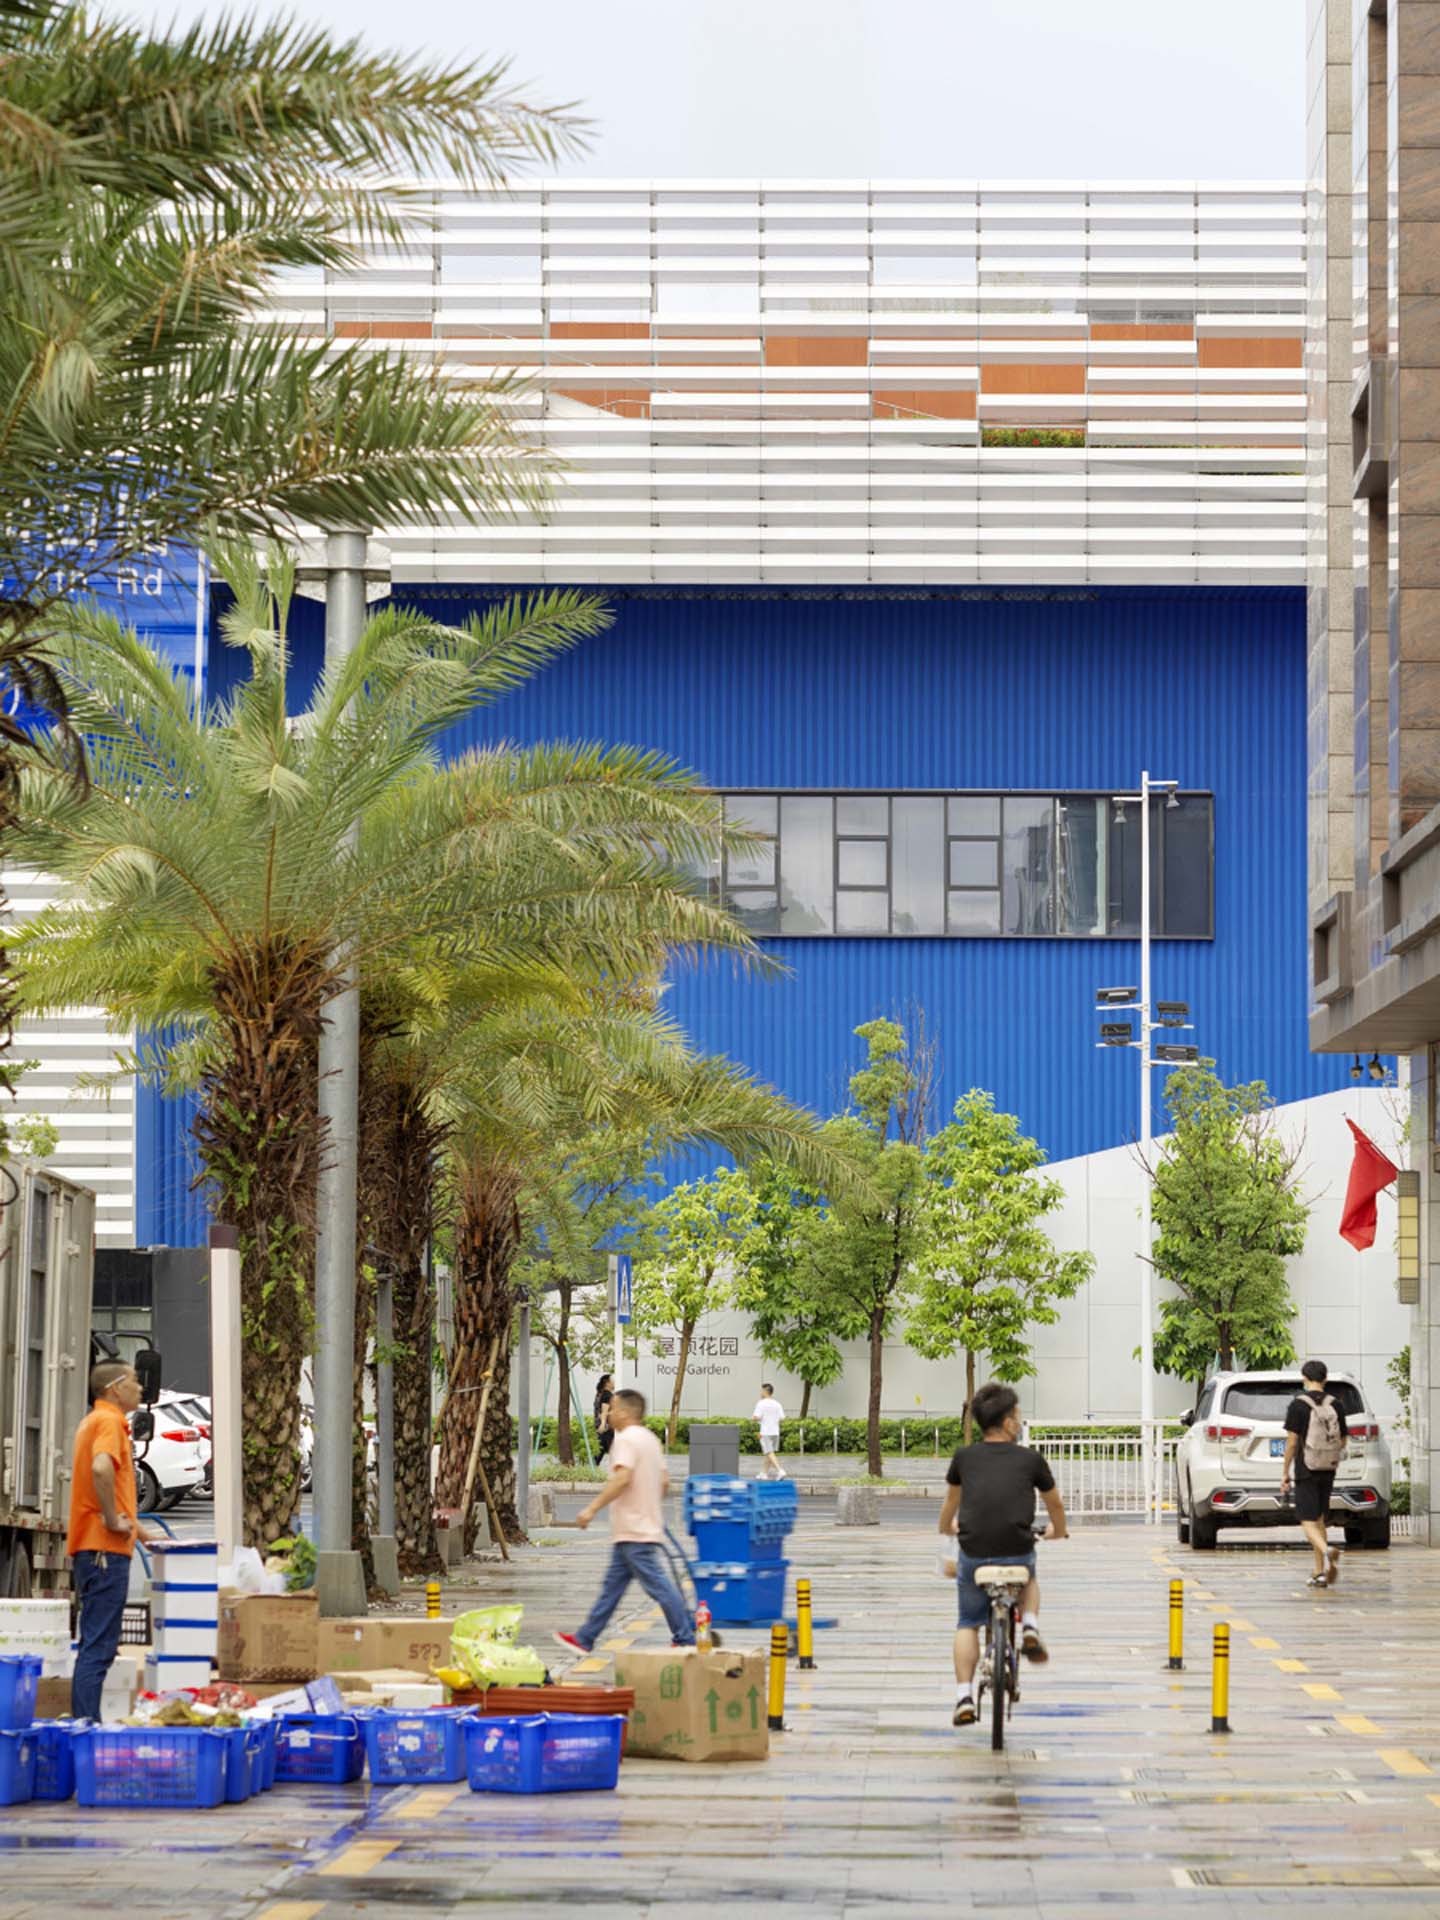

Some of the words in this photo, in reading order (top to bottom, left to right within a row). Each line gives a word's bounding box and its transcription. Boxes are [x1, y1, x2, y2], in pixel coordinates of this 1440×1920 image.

[117, 567, 162, 595] Rd
[658, 1336, 738, 1356] 屋顶花园
[656, 1363, 682, 1375] Roo
[687, 1363, 730, 1375] Garden
